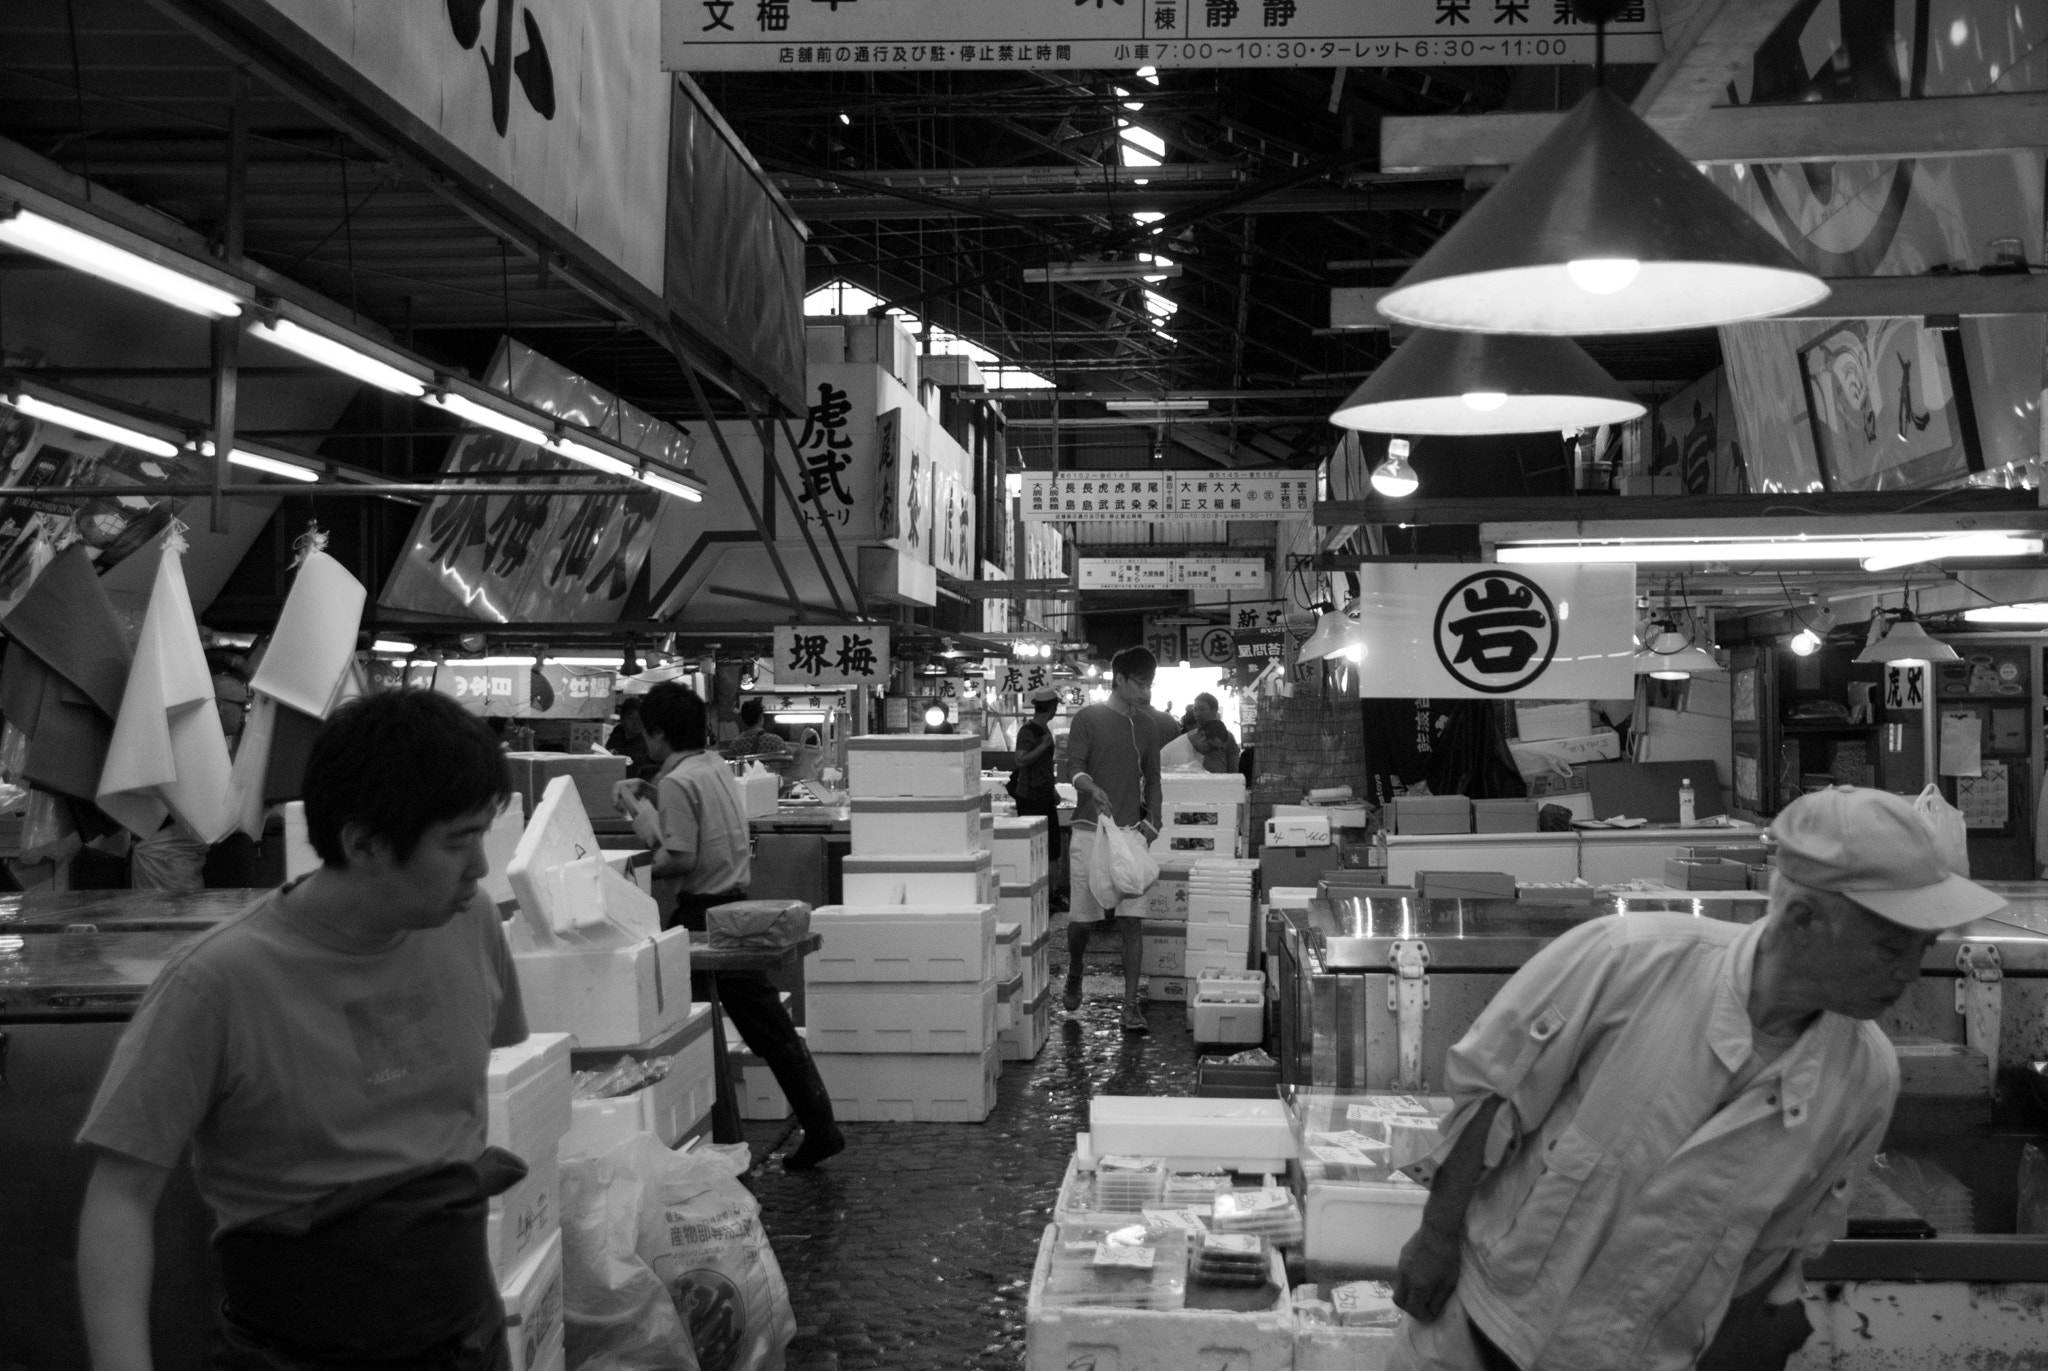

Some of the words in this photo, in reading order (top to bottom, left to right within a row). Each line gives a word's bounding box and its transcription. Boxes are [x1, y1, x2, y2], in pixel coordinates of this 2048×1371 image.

[1154, 0, 1176, 30] 棟
[779, 45, 1071, 64] 店舗前の通行及び駐・停止禁止時間
[797, 382, 854, 506] 虎武
[1066, 482, 1075, 510] 長島
[1082, 482, 1093, 510] 長島
[1098, 482, 1109, 510] 虎武
[1115, 482, 1125, 510] 虎武
[1180, 482, 1191, 510] 大正
[1448, 578, 1546, 674] 岩
[788, 633, 878, 677] 堺梅
